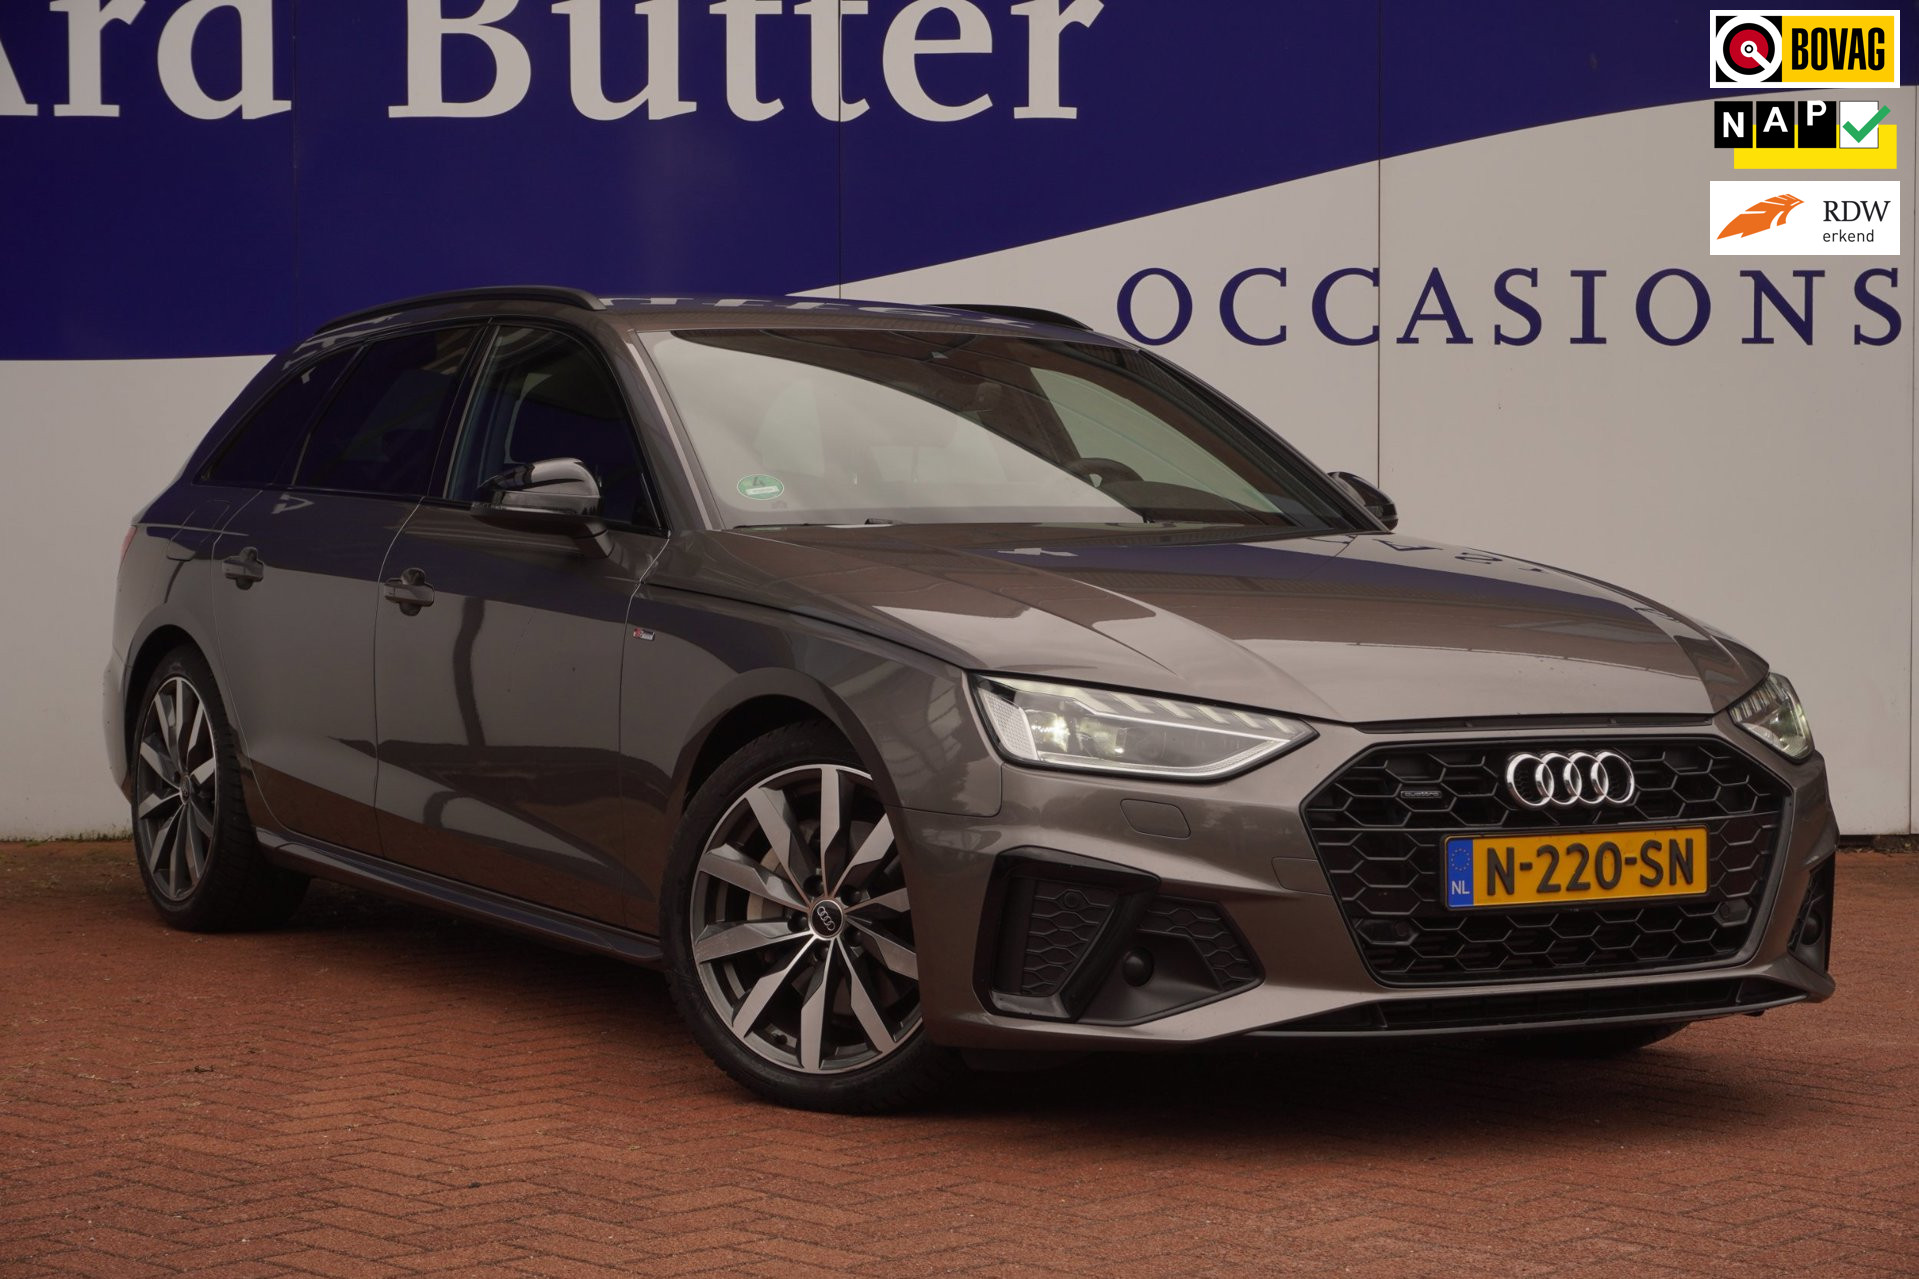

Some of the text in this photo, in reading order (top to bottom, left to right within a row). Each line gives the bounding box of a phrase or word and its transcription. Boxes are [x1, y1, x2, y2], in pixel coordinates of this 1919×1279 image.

[0, 0, 1104, 122] rd Butter
[1116, 266, 1903, 347] OCCASIONS
[1451, 837, 1694, 897] NL N-220-SN
